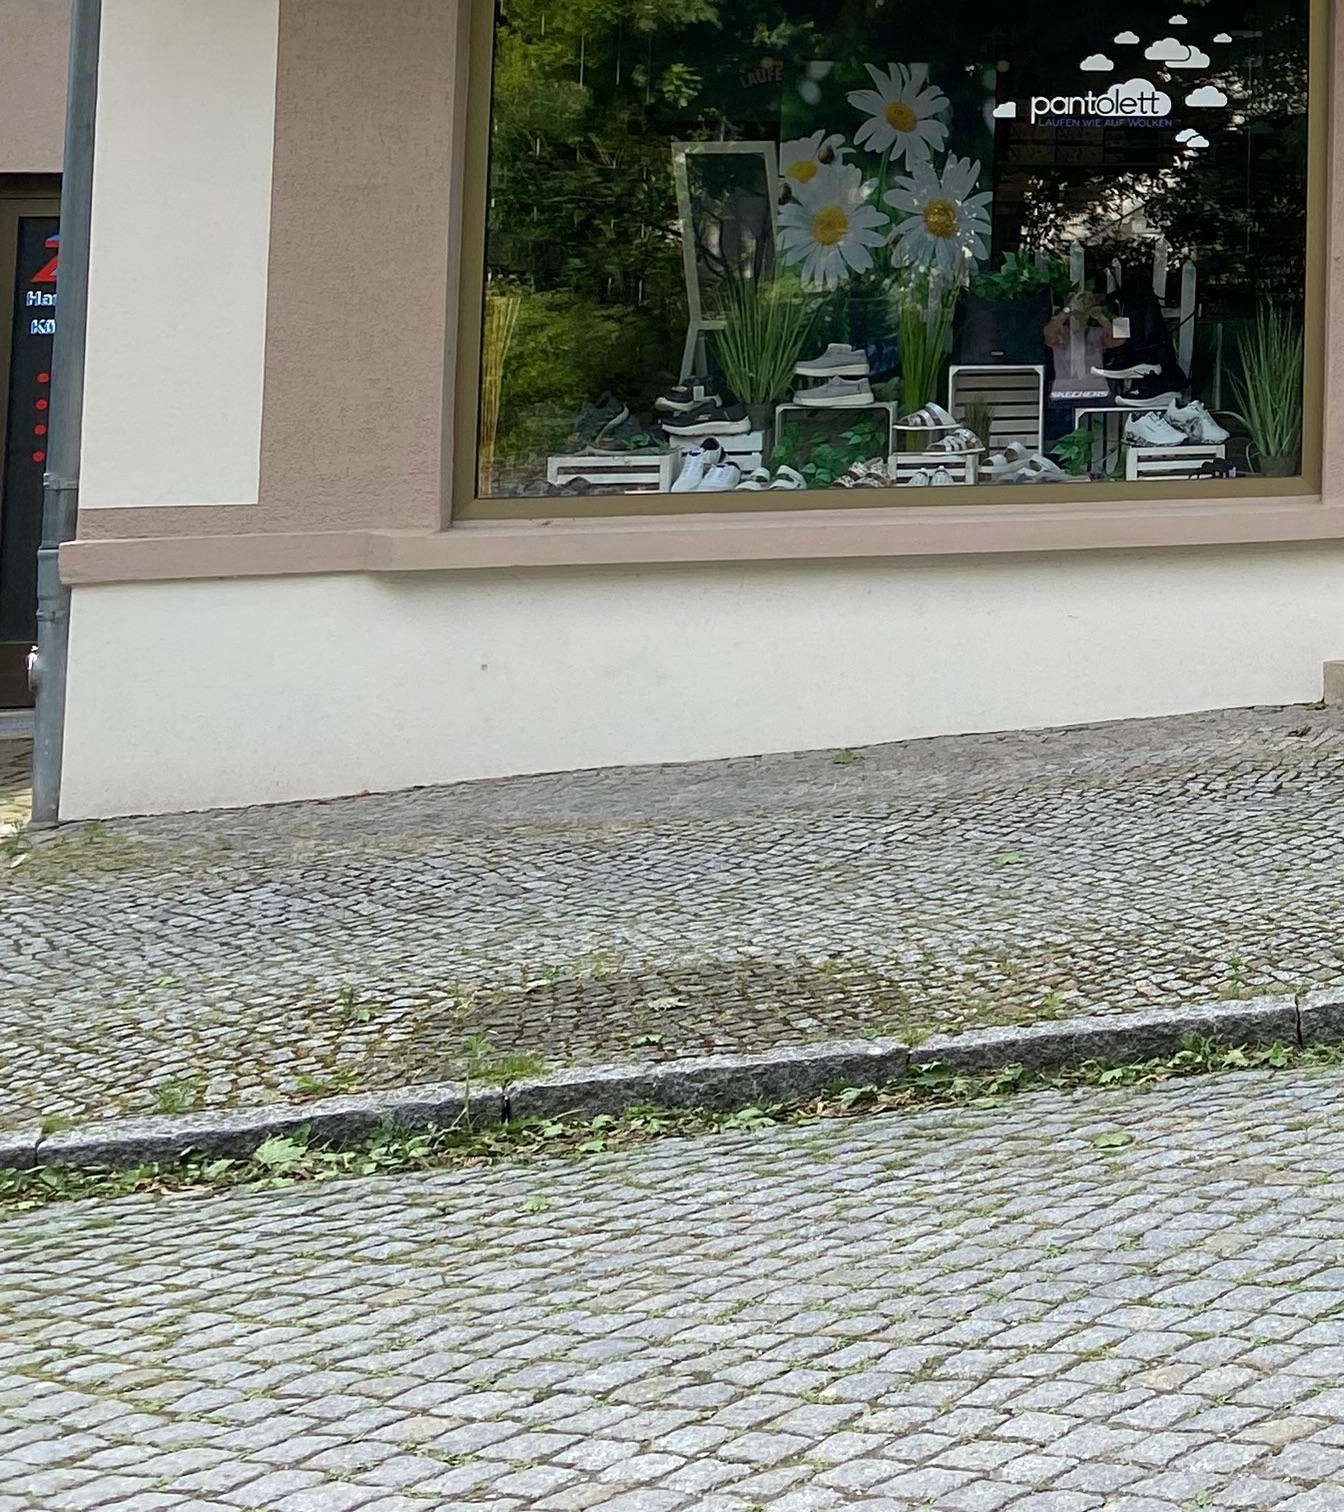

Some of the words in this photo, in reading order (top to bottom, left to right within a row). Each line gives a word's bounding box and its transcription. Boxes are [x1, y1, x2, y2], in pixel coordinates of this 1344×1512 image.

[1030, 89, 1160, 124] pantolett
[1128, 119, 1172, 127] WOLKEN
[1051, 391, 1109, 399] SKECHERS
